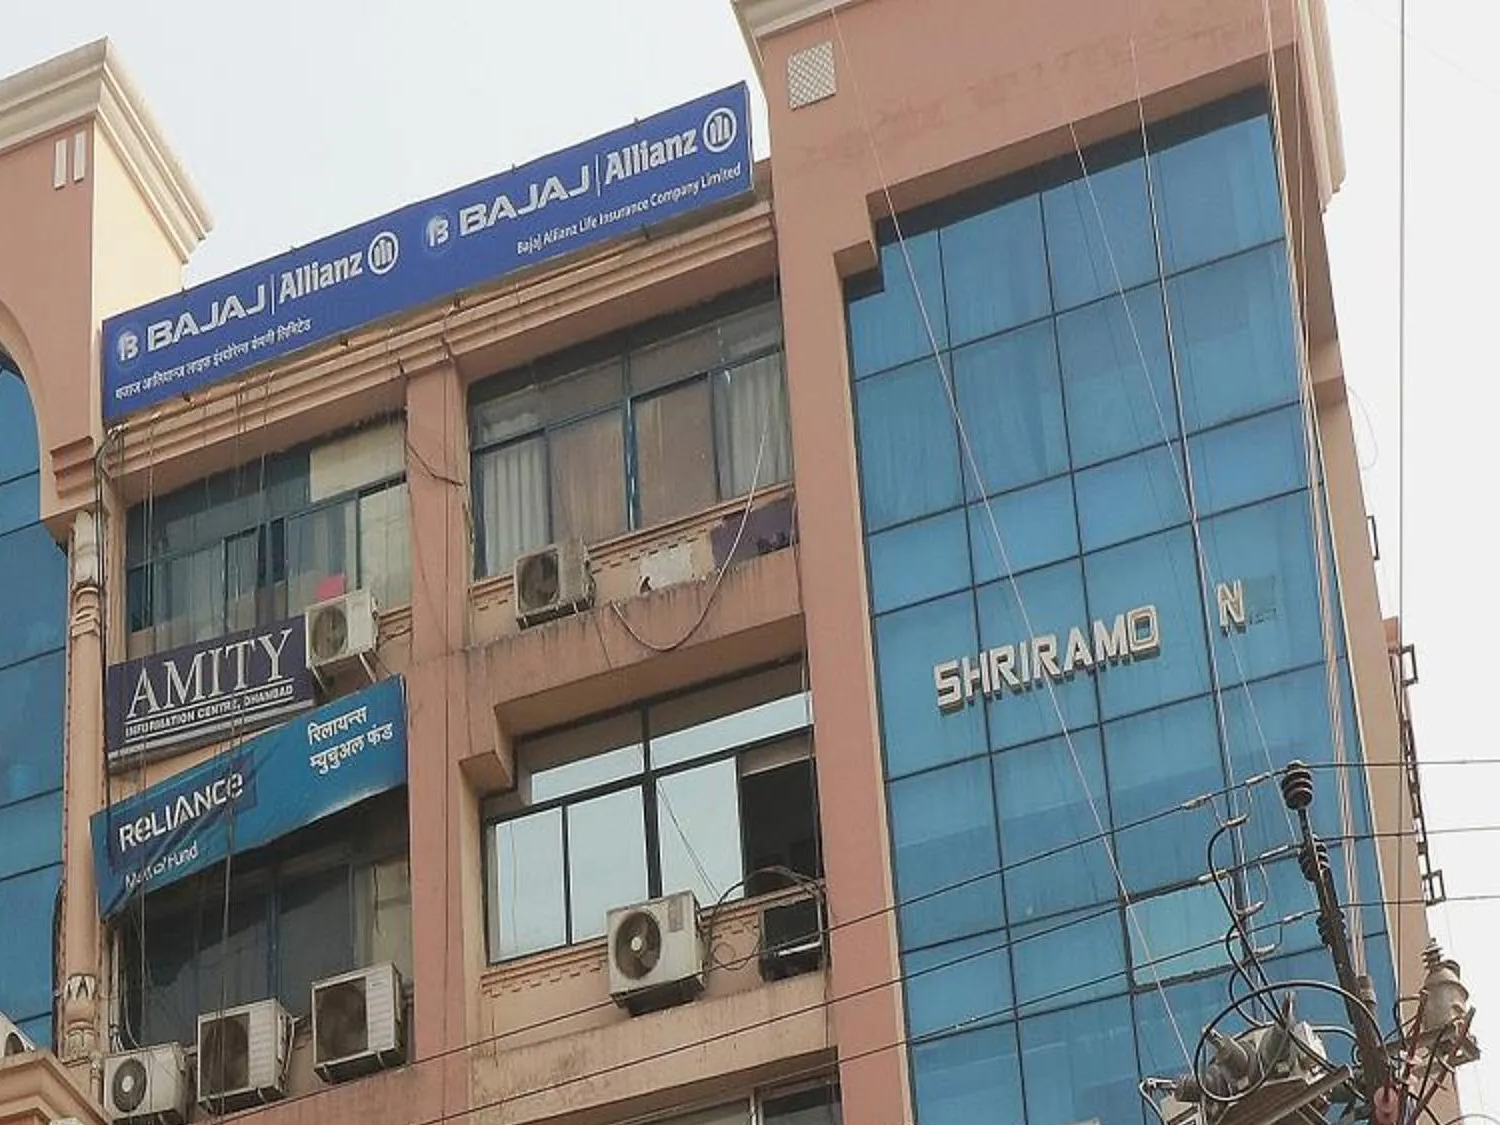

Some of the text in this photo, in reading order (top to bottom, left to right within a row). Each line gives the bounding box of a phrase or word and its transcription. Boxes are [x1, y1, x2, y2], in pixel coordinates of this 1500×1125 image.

[460, 129, 697, 237] BAJAJ Allianz
[542, 221, 578, 247] Allianz
[579, 213, 598, 234] Life
[598, 196, 649, 227] Insurance
[650, 179, 699, 208] Company
[700, 162, 741, 188] Limited
[147, 250, 363, 353] BAJAJ Allianz
[126, 627, 293, 719] AMITY
